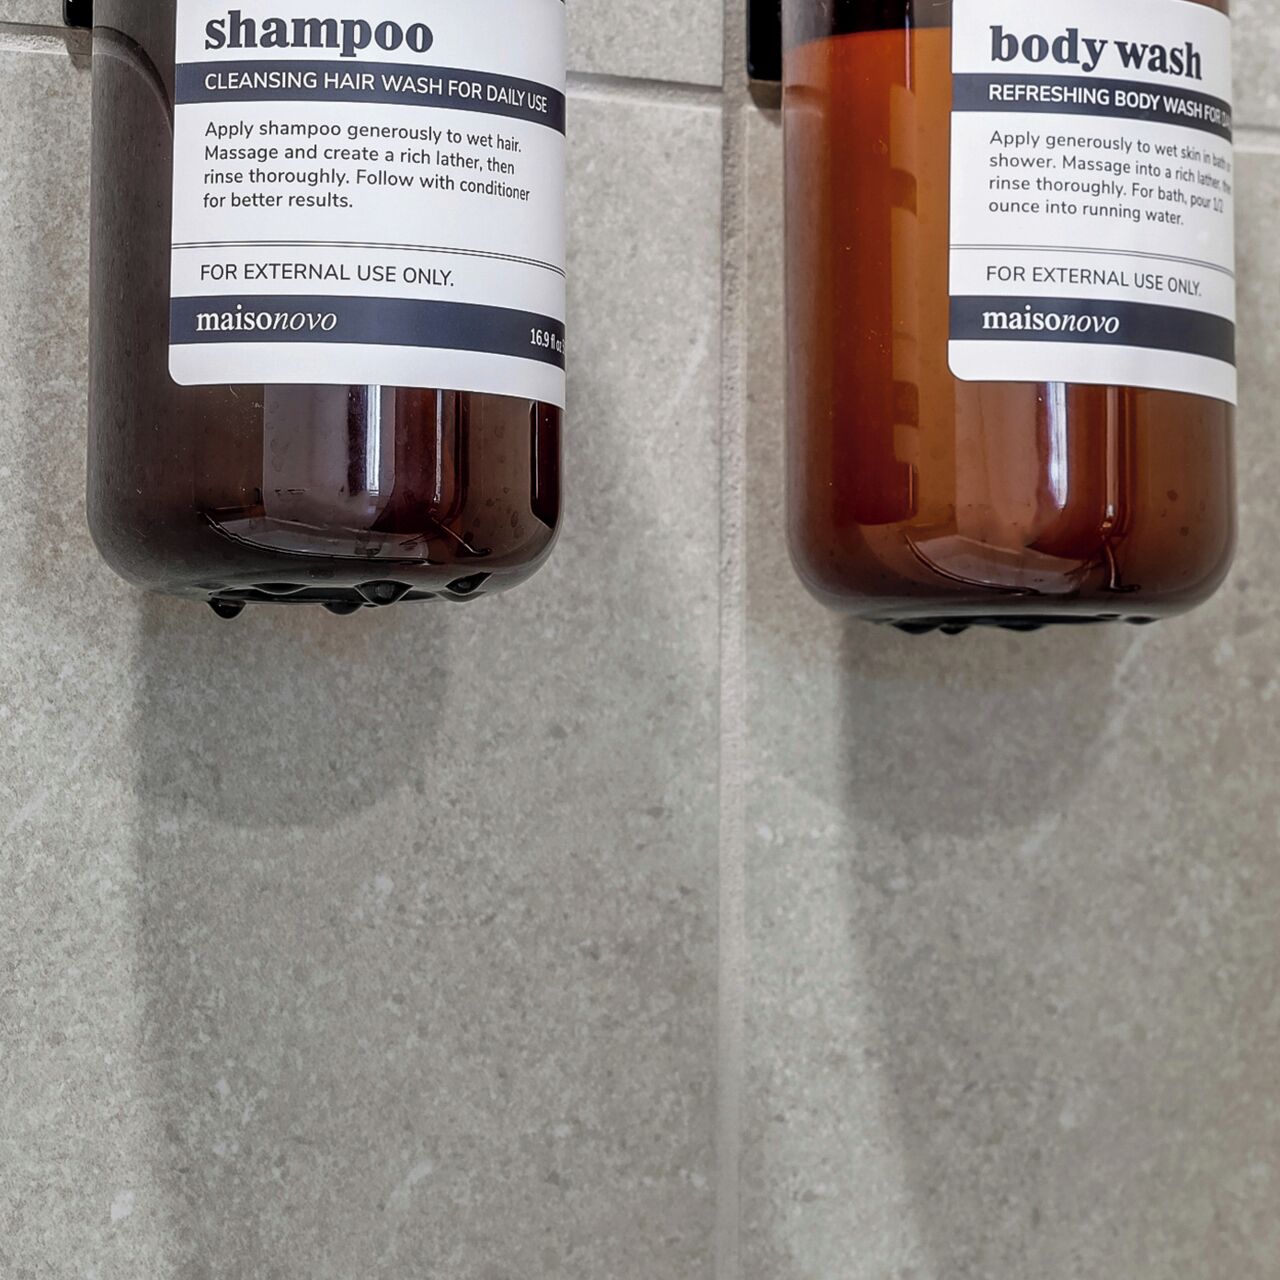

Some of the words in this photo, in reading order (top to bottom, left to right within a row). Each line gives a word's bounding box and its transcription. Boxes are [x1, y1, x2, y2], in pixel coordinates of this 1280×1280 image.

[205, 10, 433, 57] shampoo
[990, 25, 1108, 72] body
[1114, 41, 1202, 80] wash
[205, 72, 316, 89] CLEANSING
[325, 73, 374, 90] HAIR
[382, 75, 442, 94] WASH
[449, 80, 481, 99] FOR
[487, 85, 525, 106] DAILY
[528, 93, 547, 112] USE
[990, 84, 1109, 105] REFRESHING
[1115, 91, 1160, 110] BODY
[1163, 96, 1202, 118] WASH
[1204, 104, 1221, 124] FOR
[205, 121, 253, 139] Apply
[260, 120, 341, 138] shampoo
[348, 126, 441, 144] generously
[447, 129, 462, 143] to
[467, 134, 493, 148] wet
[497, 134, 521, 152] hair.
[990, 131, 1040, 148] Apply
[1046, 136, 1132, 154] generously
[1137, 140, 1150, 153] to
[1155, 145, 1177, 157] wet
[1181, 145, 1200, 162] skin
[1203, 149, 1211, 164] in
[205, 145, 278, 162] Massage
[285, 144, 317, 159] and
[324, 147, 378, 161] create
[385, 151, 393, 161] a
[401, 148, 430, 164] rich
[437, 151, 482, 171] lather,
[487, 157, 514, 174] then
[990, 153, 1057, 168] shower.
[1063, 155, 1130, 176] Massage
[1136, 161, 1160, 177] into
[1165, 168, 1171, 178] a
[1175, 166, 1195, 183] rich
[205, 169, 243, 184] rinse
[249, 168, 349, 186] thoroughly.
[357, 169, 414, 186] Follow
[420, 174, 454, 190] with
[460, 180, 530, 201] conditioner
[990, 176, 1030, 190] rinse
[1036, 177, 1126, 198] thoroughly.
[1132, 183, 1154, 198] For
[1158, 185, 1187, 206] bath,
[1190, 194, 1211, 208] pour
[203, 193, 226, 208] for
[232, 192, 283, 207] better
[289, 192, 352, 207] results.
[989, 202, 1039, 213] ounce
[1046, 202, 1077, 214] into
[1083, 204, 1140, 222] running
[1146, 211, 1183, 224] water.
[201, 264, 237, 280] FOR
[245, 263, 350, 280] EXTERNAL
[358, 265, 396, 282] USE
[403, 267, 453, 286] ONLY.
[987, 266, 1025, 281] FOR
[1033, 267, 1129, 286] EXTERNAL
[1135, 273, 1163, 290] USE
[1168, 277, 1201, 296] ONLY.
[197, 304, 336, 330] maisonovo
[983, 305, 1119, 333] maisonovo
[530, 328, 549, 348] 16.9
